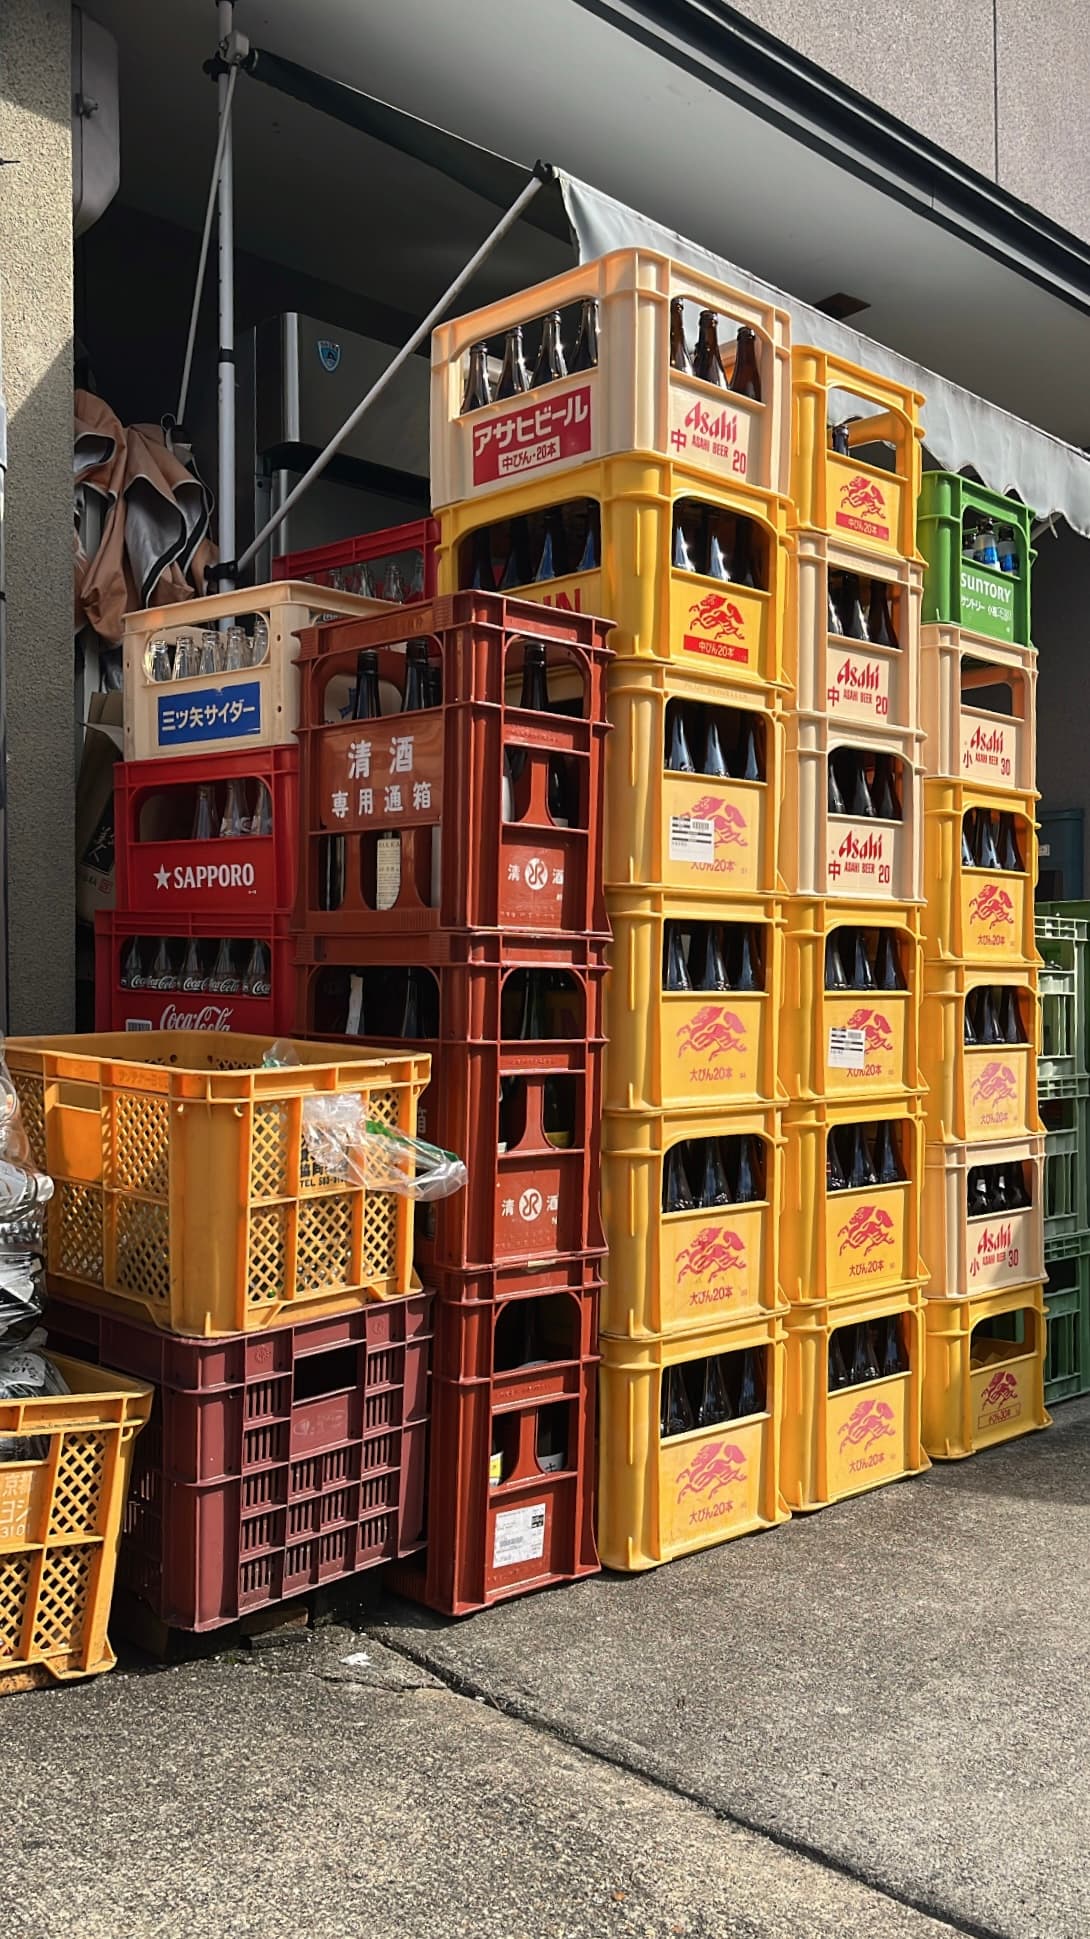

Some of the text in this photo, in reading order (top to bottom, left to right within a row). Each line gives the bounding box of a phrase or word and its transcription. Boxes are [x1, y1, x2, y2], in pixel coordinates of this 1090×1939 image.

[474, 395, 589, 457] アサヒビール
[685, 401, 738, 445] Asahi
[671, 428, 747, 475] 中 ASAHI BEER 20
[837, 657, 880, 691] Asahi
[828, 686, 840, 707] 中
[860, 692, 872, 705] BEER
[875, 695, 888, 715] 20
[162, 699, 256, 732] 三ツ矢サイダー
[970, 725, 1004, 754] Asahi
[348, 735, 415, 779] 清酒
[963, 749, 973, 769] 小
[1001, 757, 1011, 776] 30
[331, 781, 432, 818] 専用通箱
[838, 830, 883, 860] Asahi
[173, 863, 255, 889] SAPPORO
[828, 860, 890, 884] 中 ASAHI BEER 20
[689, 1066, 733, 1082] 大びん20本
[977, 1223, 1011, 1255] Asahi
[849, 1260, 885, 1277] 大びん20本
[970, 1257, 980, 1277] 小
[1008, 1248, 1019, 1268] 30
[689, 1283, 733, 1306] 大びん20本
[688, 1500, 734, 1526] 大びん20本
